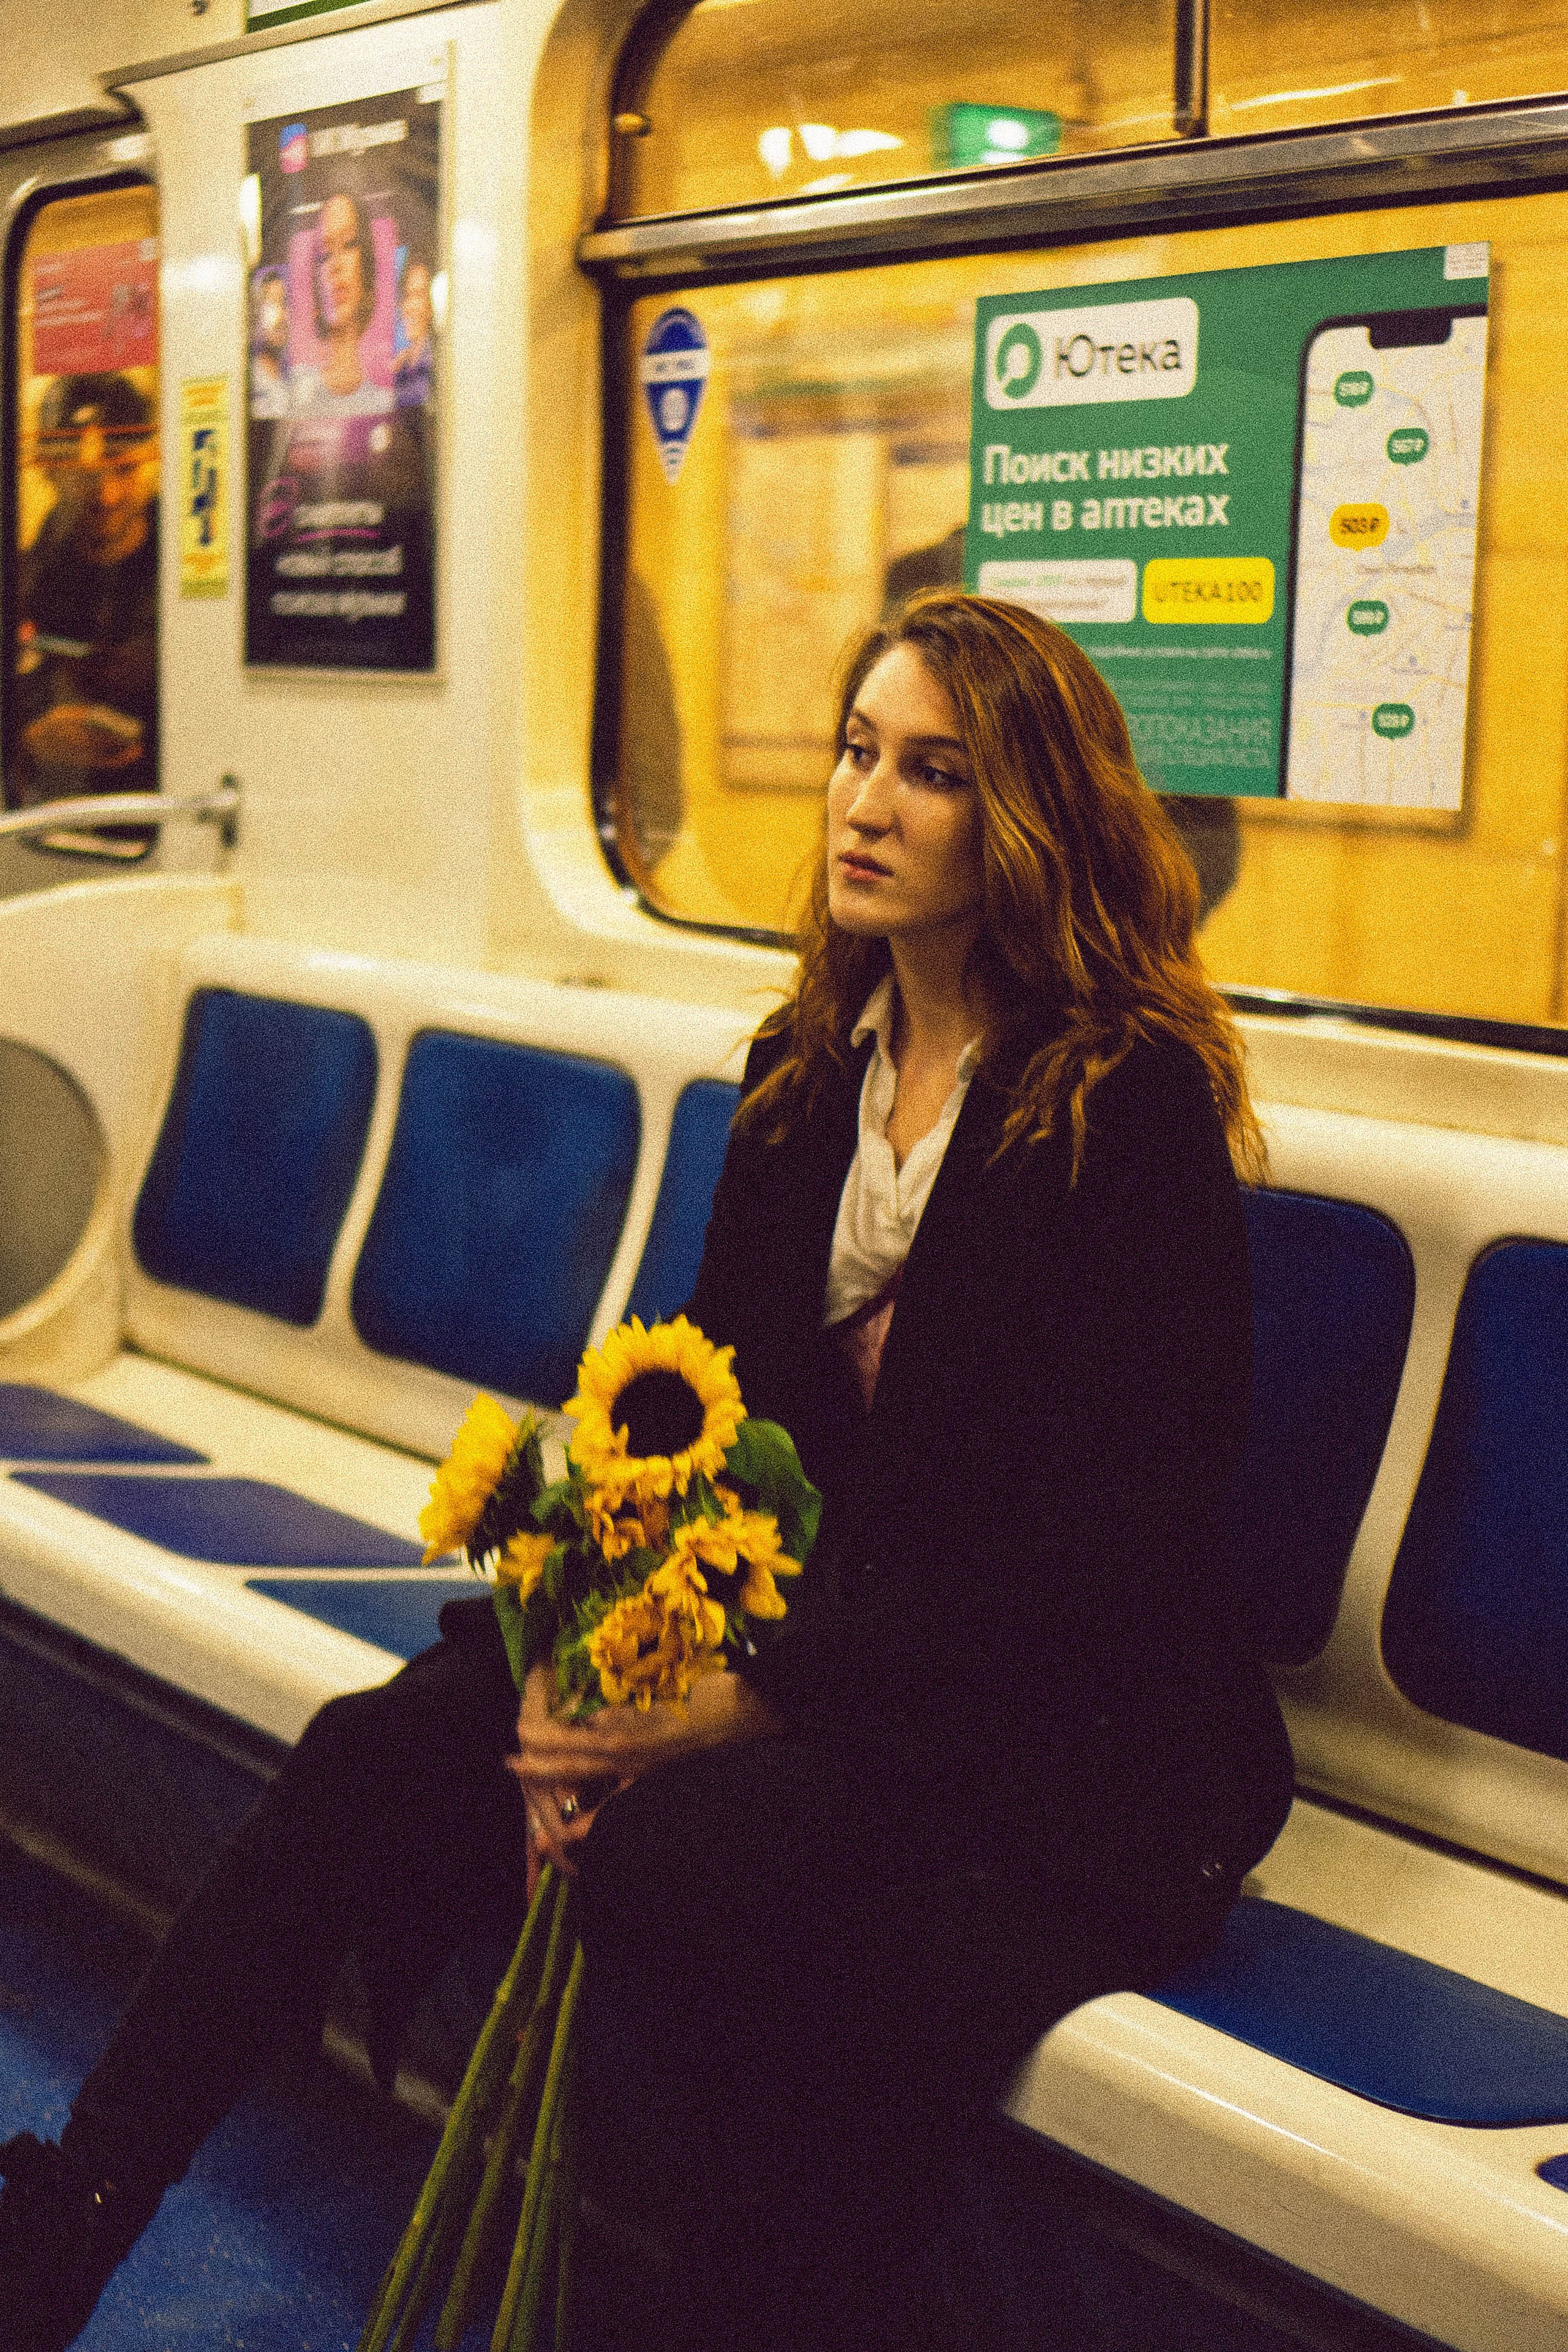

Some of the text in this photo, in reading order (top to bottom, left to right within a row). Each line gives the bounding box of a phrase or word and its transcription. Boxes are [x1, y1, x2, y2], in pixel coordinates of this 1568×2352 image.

[1055, 332, 1182, 379] Ютека
[984, 442, 1230, 484] Поиск низких
[982, 494, 1231, 538] цен в аптеках
